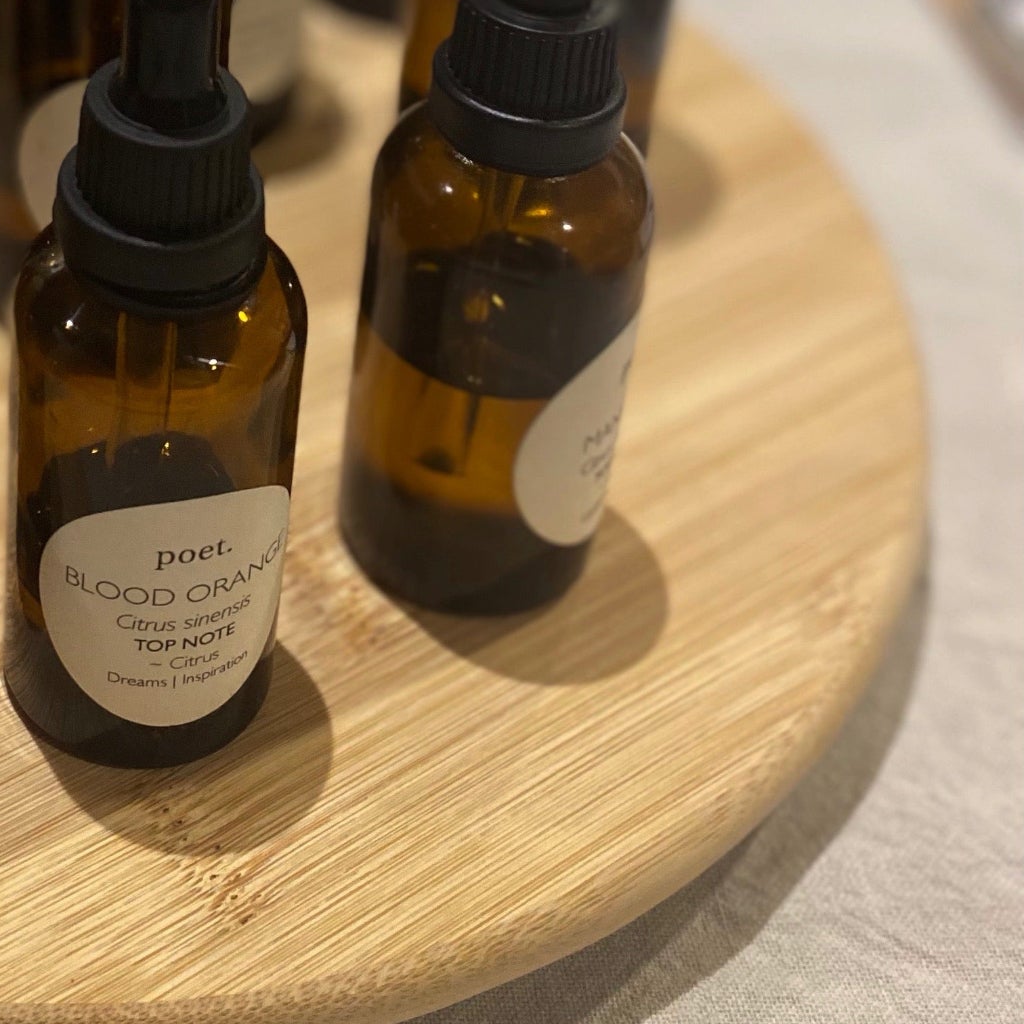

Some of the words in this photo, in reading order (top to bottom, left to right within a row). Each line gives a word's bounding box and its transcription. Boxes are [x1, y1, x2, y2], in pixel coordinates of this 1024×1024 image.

[154, 538, 233, 570] poet.
[65, 565, 175, 607] BLOOD
[116, 614, 176, 632] Citrus
[183, 594, 251, 630] sinensis
[134, 639, 177, 652] TOP
[182, 621, 236, 650] NOTE
[107, 671, 168, 688] Dreams
[182, 649, 248, 685] Inspiration
[169, 650, 220, 670] Citrus
